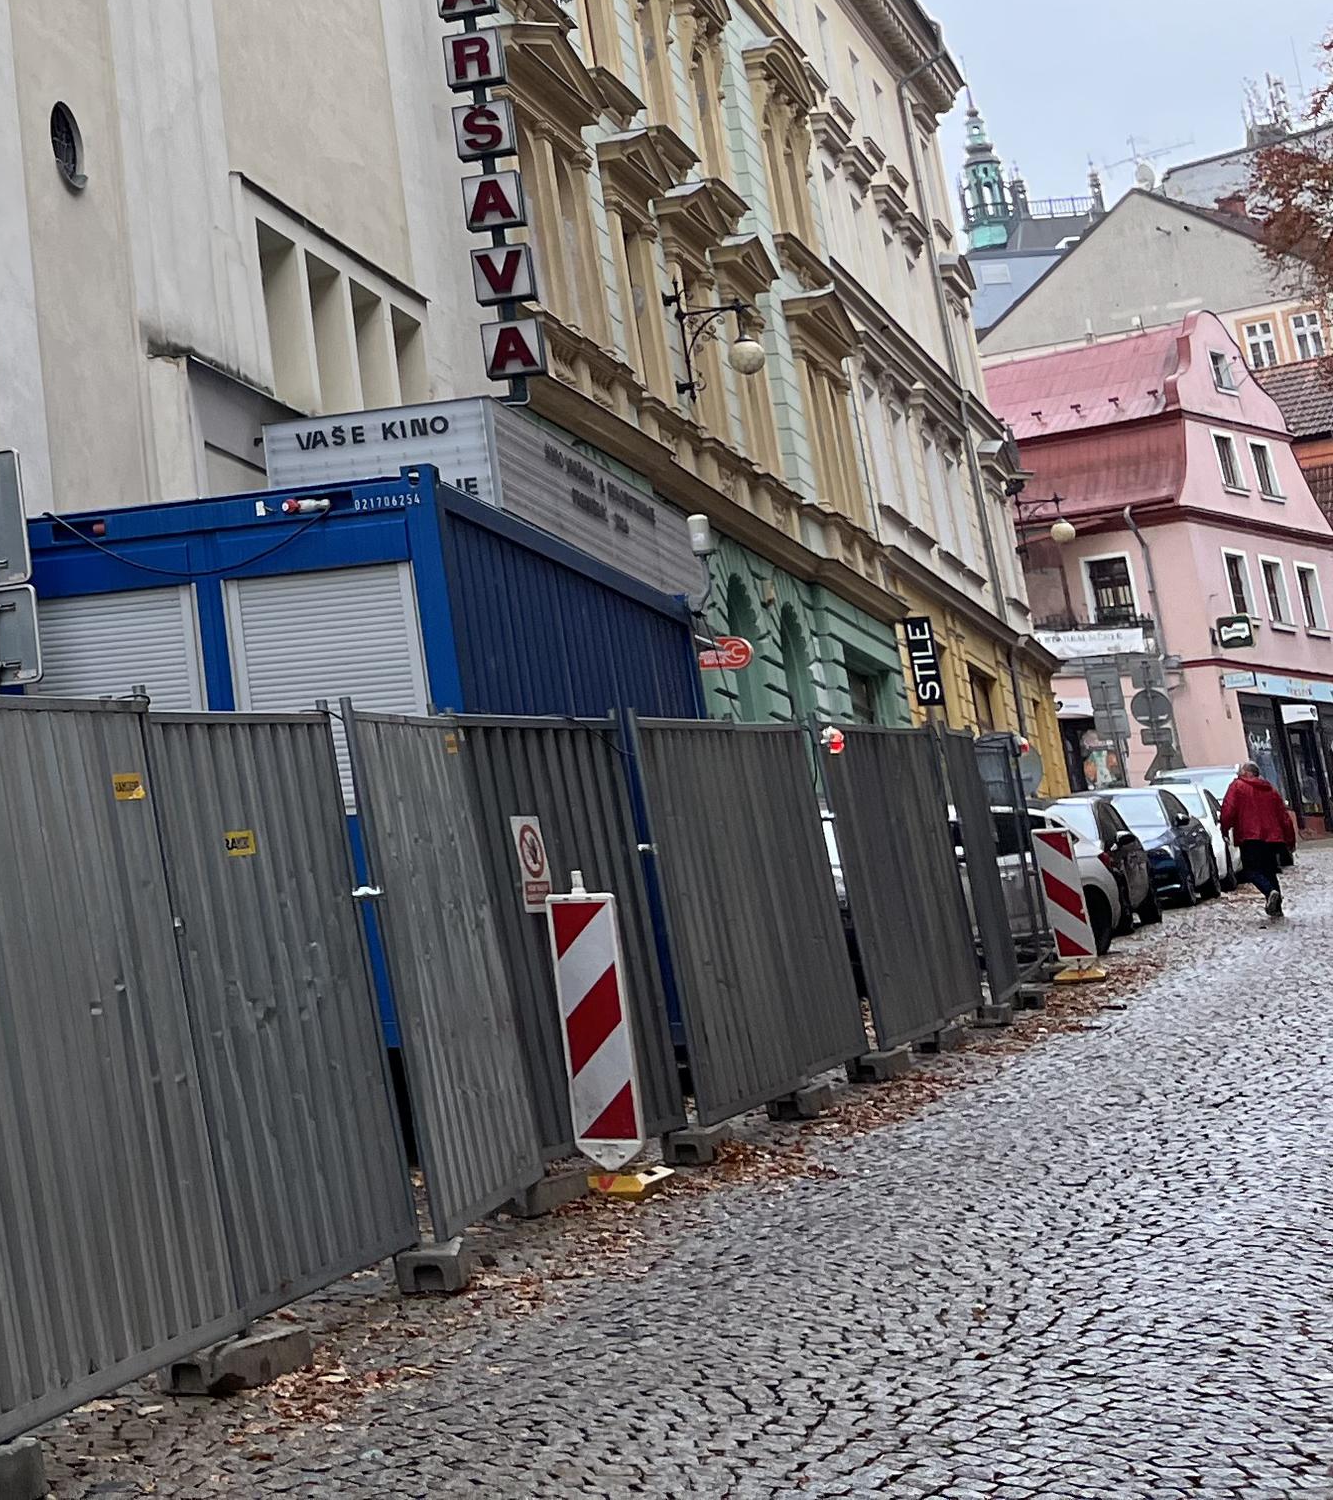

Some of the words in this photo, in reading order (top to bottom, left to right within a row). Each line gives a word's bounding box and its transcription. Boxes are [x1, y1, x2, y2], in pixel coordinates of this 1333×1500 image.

[295, 425, 366, 451] VAŠE
[381, 415, 450, 441] KINO
[354, 493, 420, 511] 021706254
[906, 621, 941, 700] STILE
